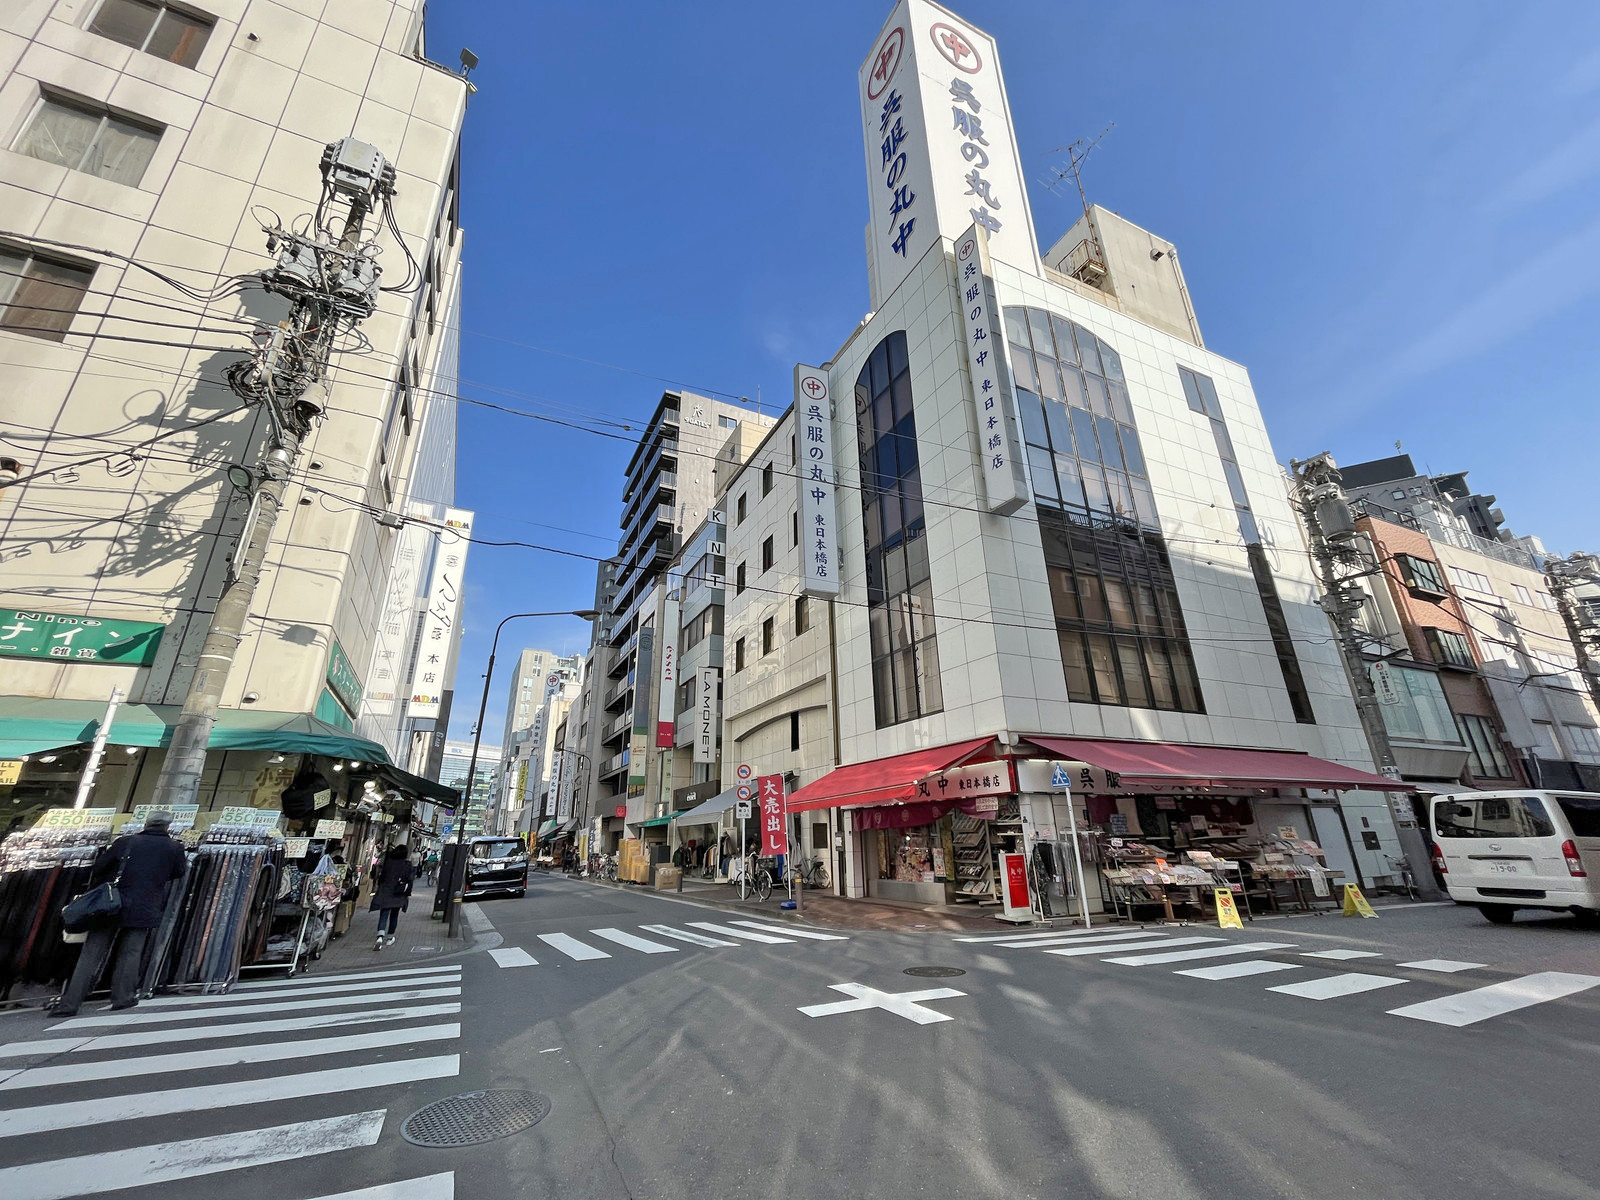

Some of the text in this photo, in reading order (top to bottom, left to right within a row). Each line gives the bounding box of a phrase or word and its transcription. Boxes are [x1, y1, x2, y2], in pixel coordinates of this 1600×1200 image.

[879, 88, 916, 258] 呉服の丸中
[949, 77, 1003, 242] 呉服の丸中
[963, 263, 990, 367] 呉服の丸中
[806, 405, 827, 506] 呉服の丸中
[980, 379, 1005, 470] 東日本橋店
[814, 513, 829, 577] 東日本橋店
[0, 621, 135, 648] ナイン
[411, 694, 439, 703] MDM
[958, 775, 1001, 790] 東日本橋店
[1080, 767, 1122, 789] 呉服
[763, 779, 782, 850] 大売出し
